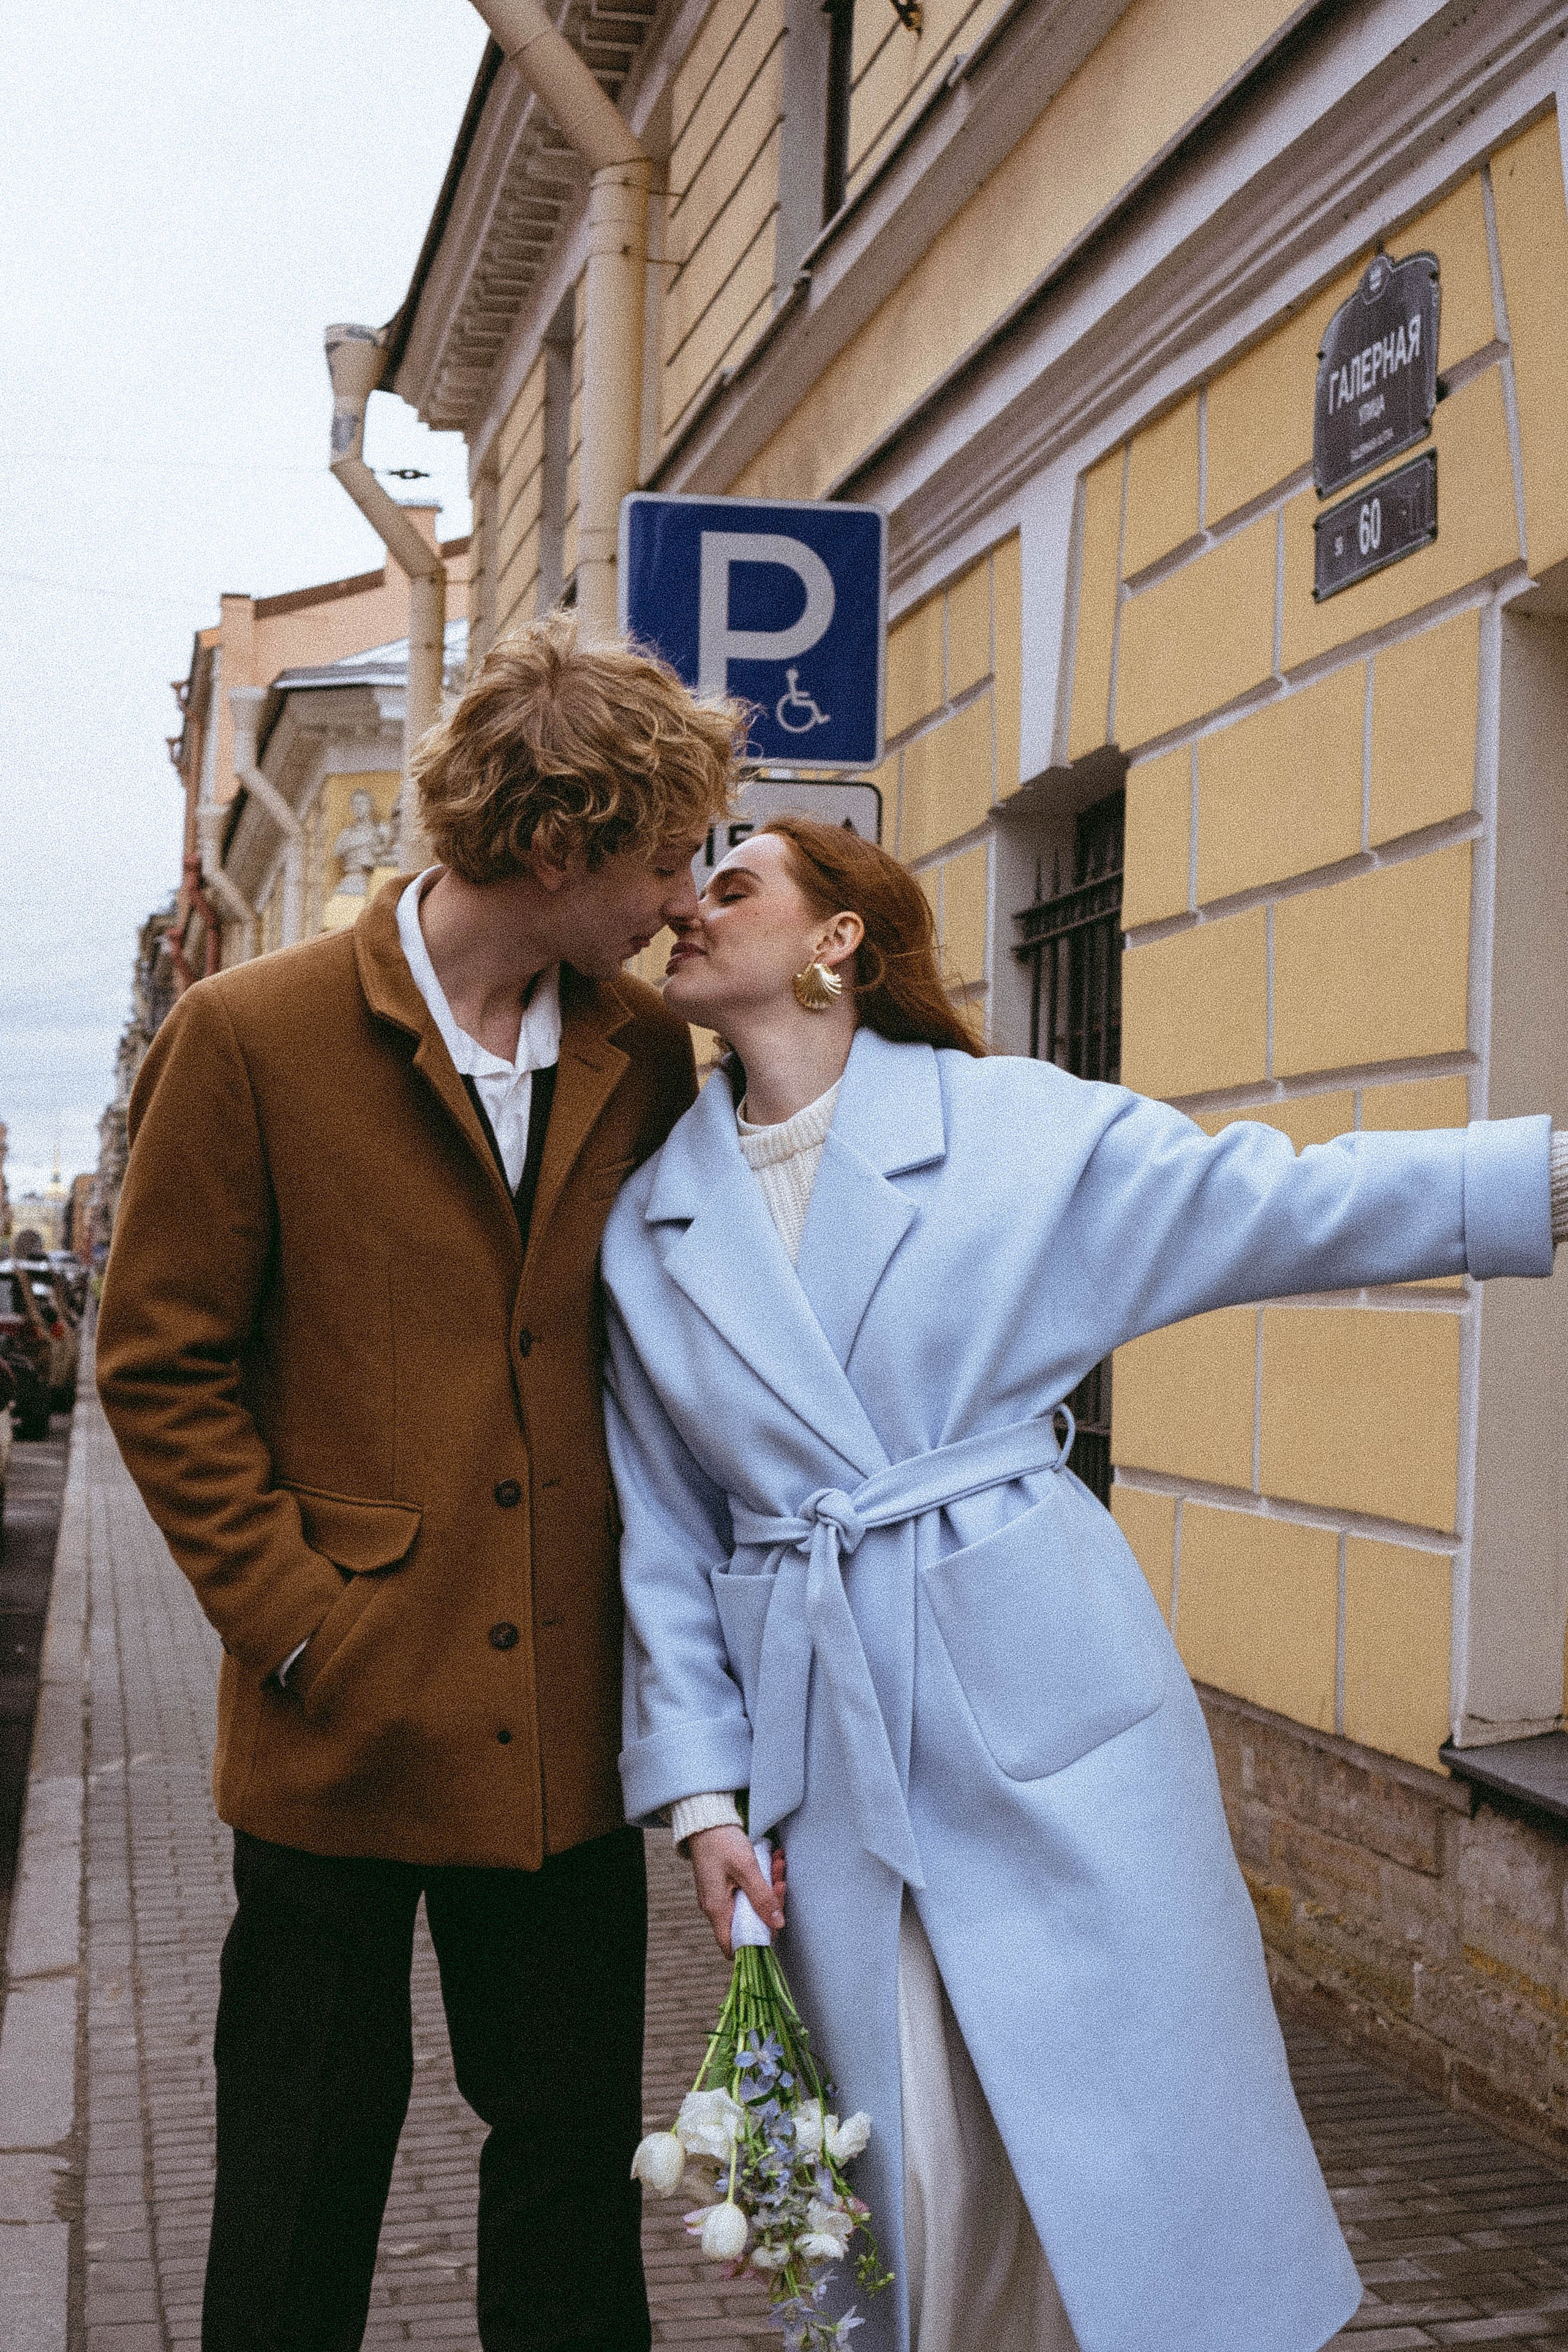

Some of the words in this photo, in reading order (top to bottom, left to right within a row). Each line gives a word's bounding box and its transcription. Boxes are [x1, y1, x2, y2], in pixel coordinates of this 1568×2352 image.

[1328, 314, 1422, 415] ГАЛЕРНАЯ
[1359, 497, 1382, 555] 60
[697, 530, 836, 709] P
